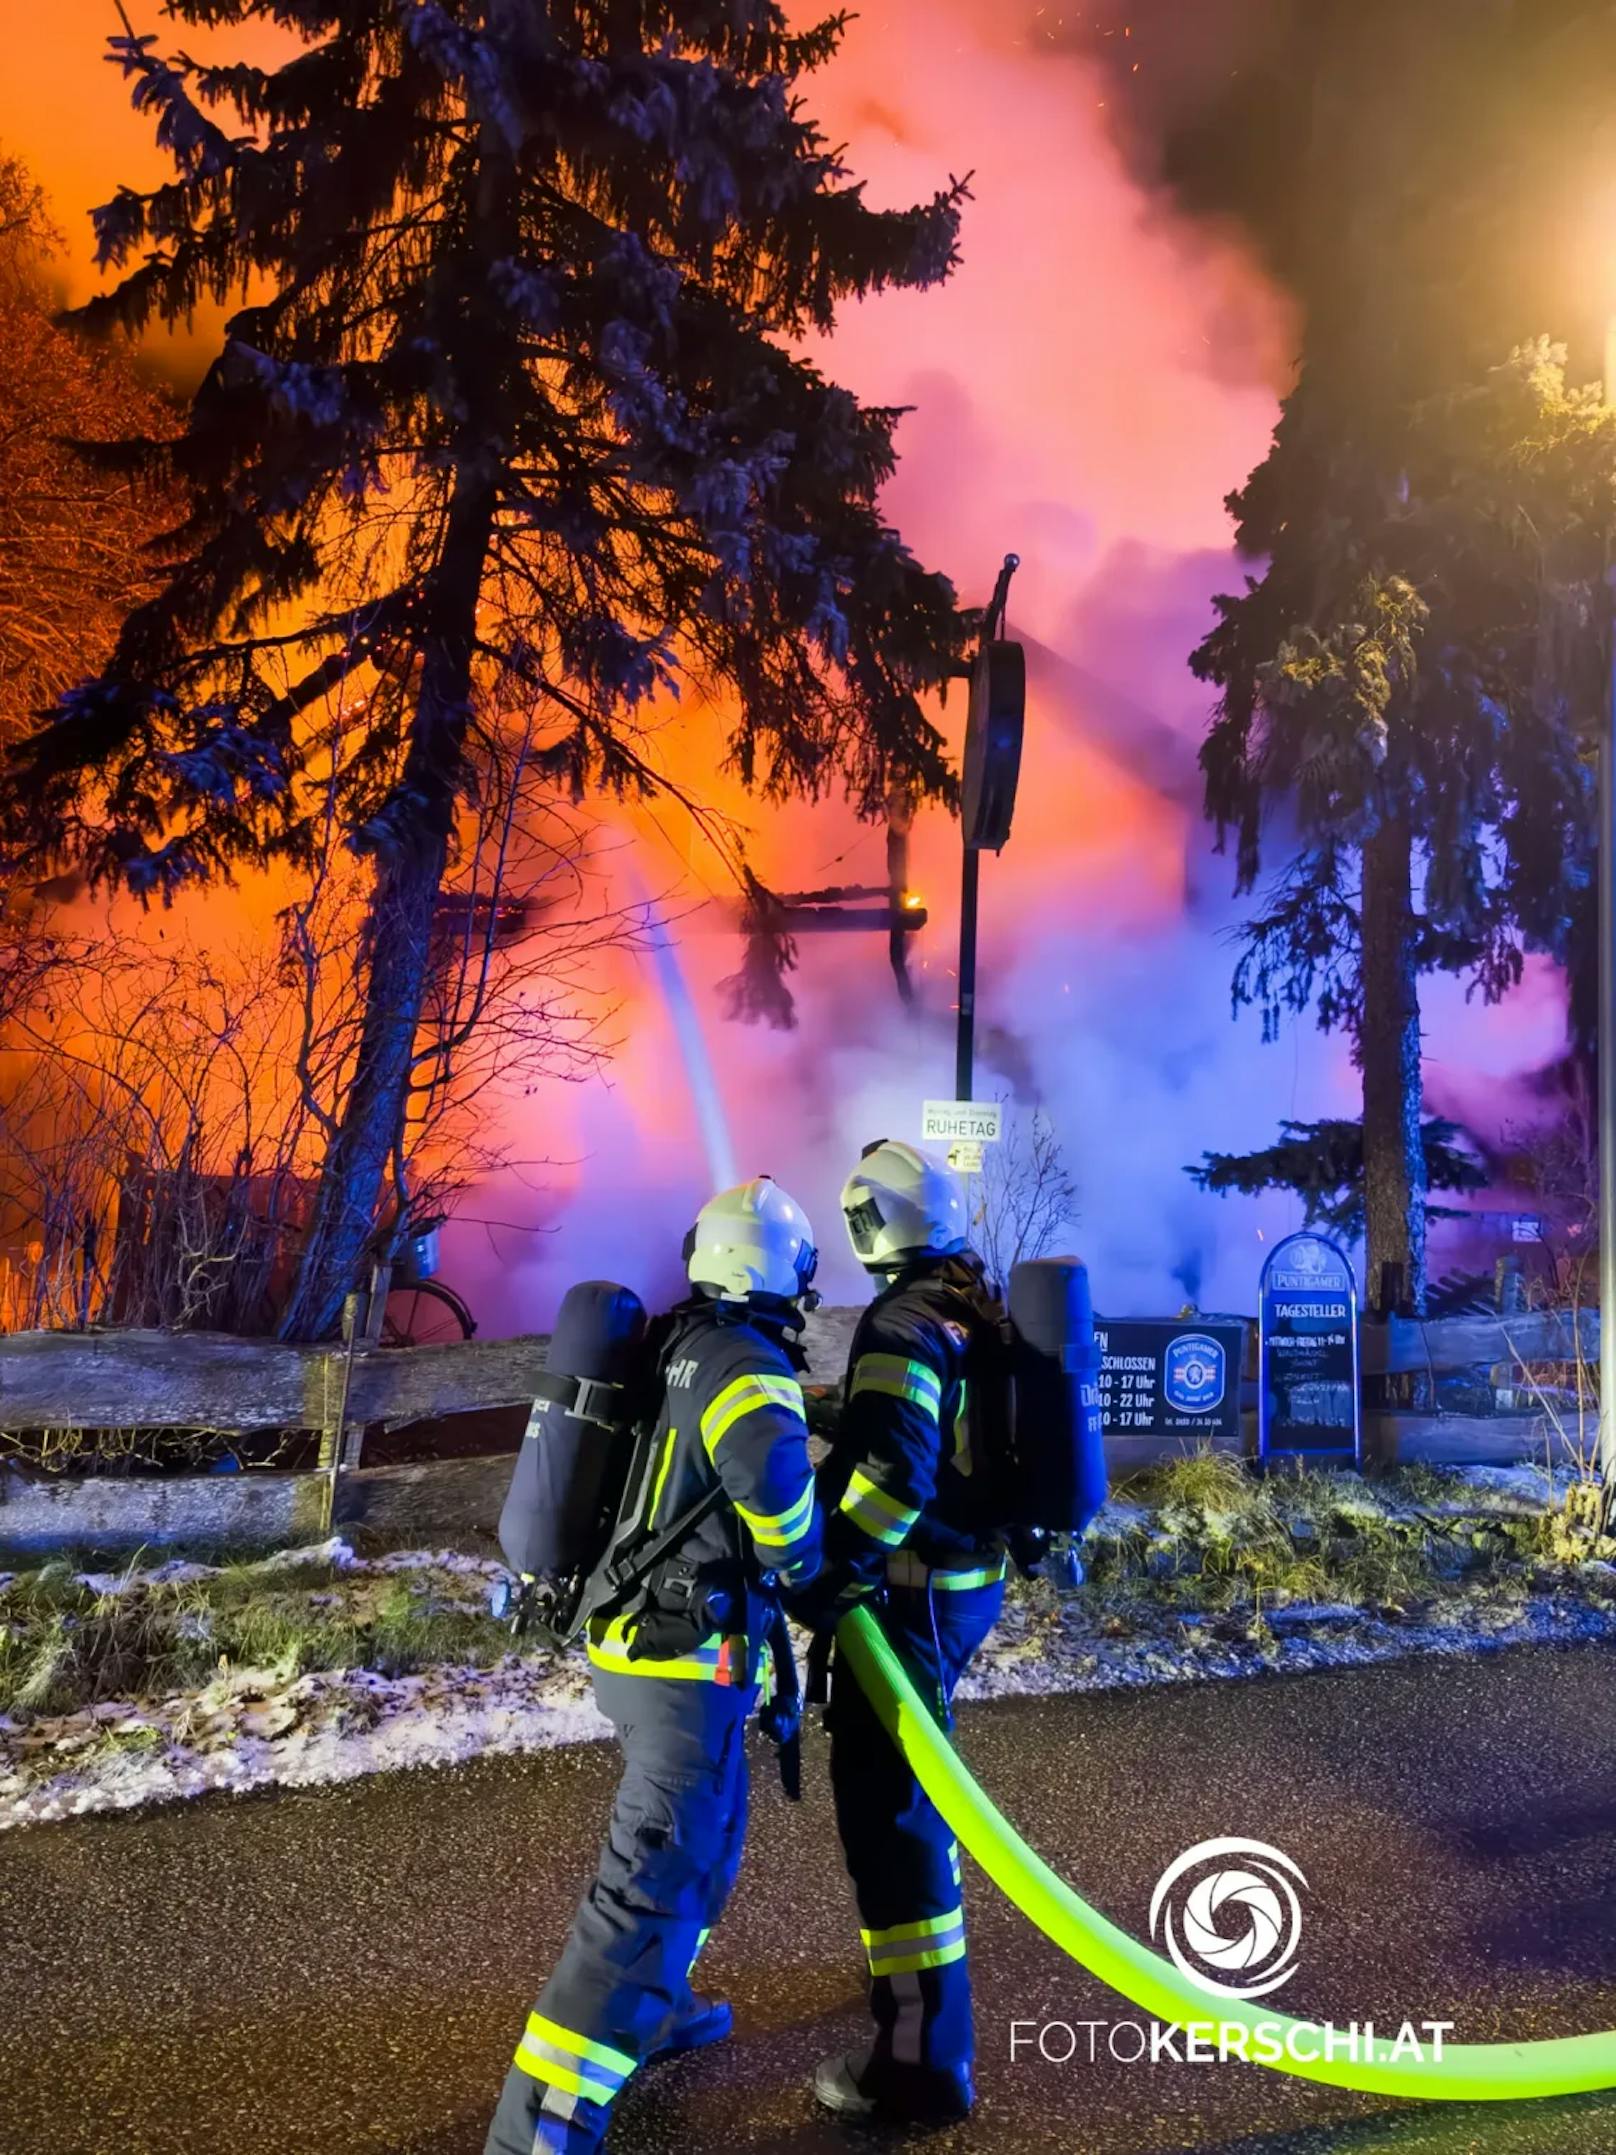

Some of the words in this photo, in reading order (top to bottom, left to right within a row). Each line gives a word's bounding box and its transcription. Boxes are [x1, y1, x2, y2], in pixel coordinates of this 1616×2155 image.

[927, 1119, 996, 1137] RUHETAG
[1274, 1303, 1346, 1318] TAGESTELLER
[1101, 1356, 1156, 1371] SCHLOSSEN
[665, 1358, 700, 1389] HR
[1098, 1374, 1112, 1389] 10
[1121, 1375, 1134, 1389] 17
[1135, 1375, 1156, 1389] Uhr
[1120, 1393, 1133, 1407] 22
[1135, 1393, 1155, 1407] Uhr
[1119, 1412, 1133, 1426] 17
[1134, 1412, 1154, 1426] Uhr
